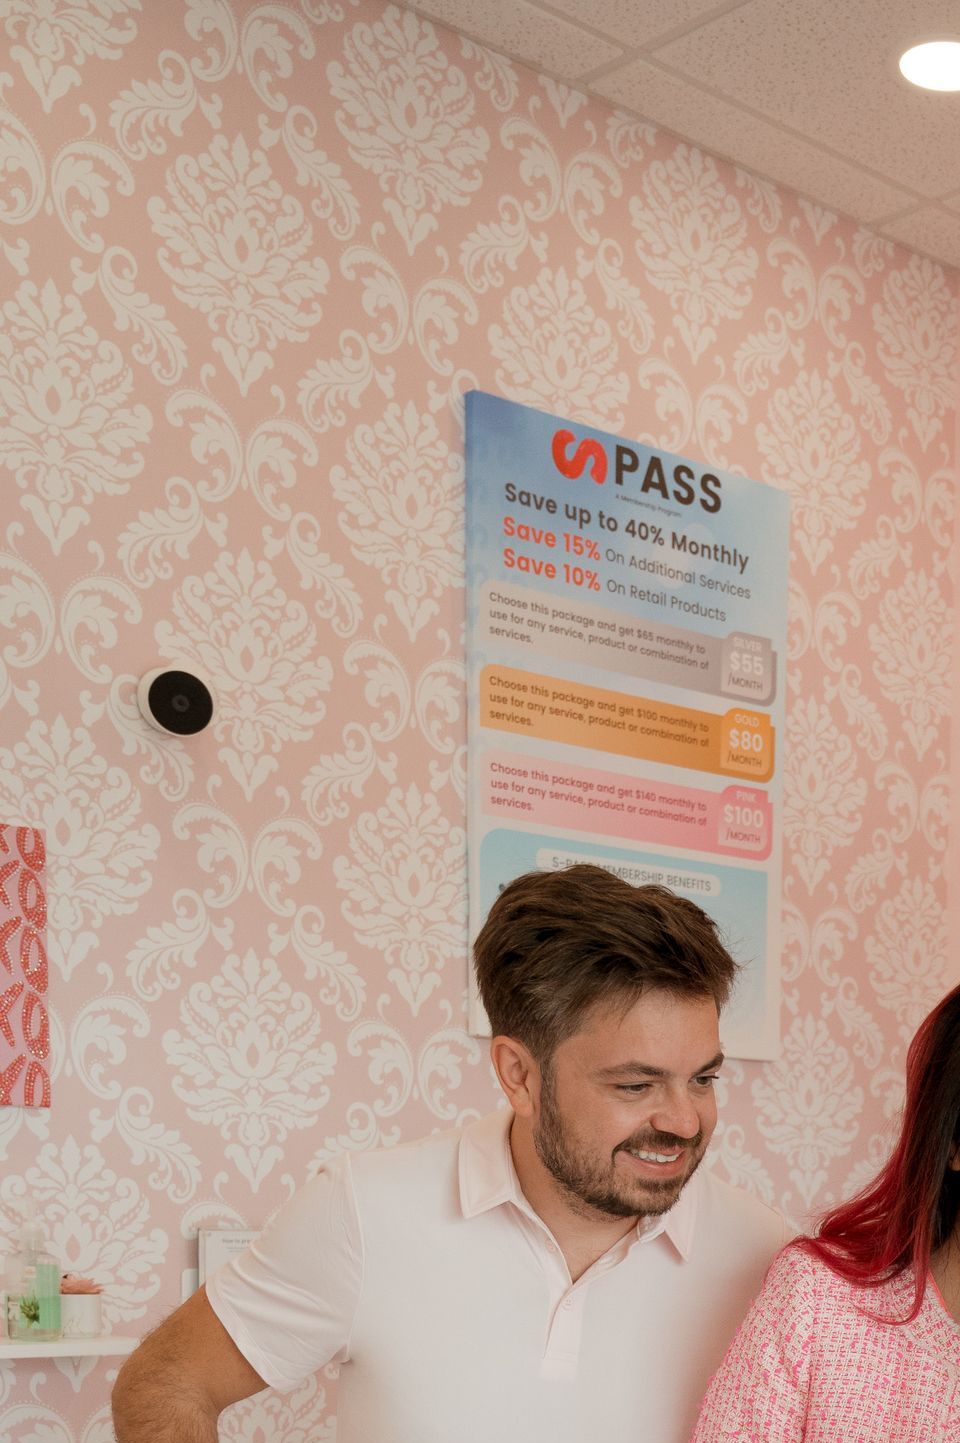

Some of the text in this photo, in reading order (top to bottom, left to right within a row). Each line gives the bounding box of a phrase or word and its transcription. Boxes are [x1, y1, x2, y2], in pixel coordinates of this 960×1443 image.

[615, 444, 722, 514] PASS
[505, 482, 749, 575] Save up to 40% Monthly
[503, 516, 751, 599] Save 15% On Additional Services
[503, 548, 727, 622] Save 10% On Retail Products
[489, 591, 528, 610] Choose
[530, 601, 550, 616] this
[552, 608, 595, 629] package
[597, 618, 616, 633] and
[618, 626, 634, 637] get
[656, 635, 694, 653] monthly
[696, 644, 706, 654] to
[489, 625, 533, 644] services.
[489, 610, 709, 670] use for any service, product or combination of
[489, 675, 528, 694] Choose
[530, 685, 550, 699] this
[552, 691, 595, 712] package
[597, 702, 616, 716] and
[618, 706, 634, 717] get
[660, 715, 698, 732] monthly
[699, 722, 710, 733] to
[728, 671, 763, 691] /MONTH
[489, 709, 533, 727] services.
[489, 695, 709, 747] use for any service, product or combination of
[729, 728, 763, 753] $80
[727, 750, 762, 769] /MONTH
[490, 762, 529, 778] Choose
[531, 769, 550, 783] this
[552, 775, 595, 792] package
[597, 782, 616, 795] and
[617, 788, 633, 799] get
[658, 795, 696, 812] monthly
[698, 802, 707, 811] to
[490, 780, 707, 826] use for any service, product or combination of
[490, 795, 534, 812] services.
[723, 804, 764, 828] $100
[726, 827, 761, 845] /MONTH
[667, 874, 712, 892] BENEFITS
